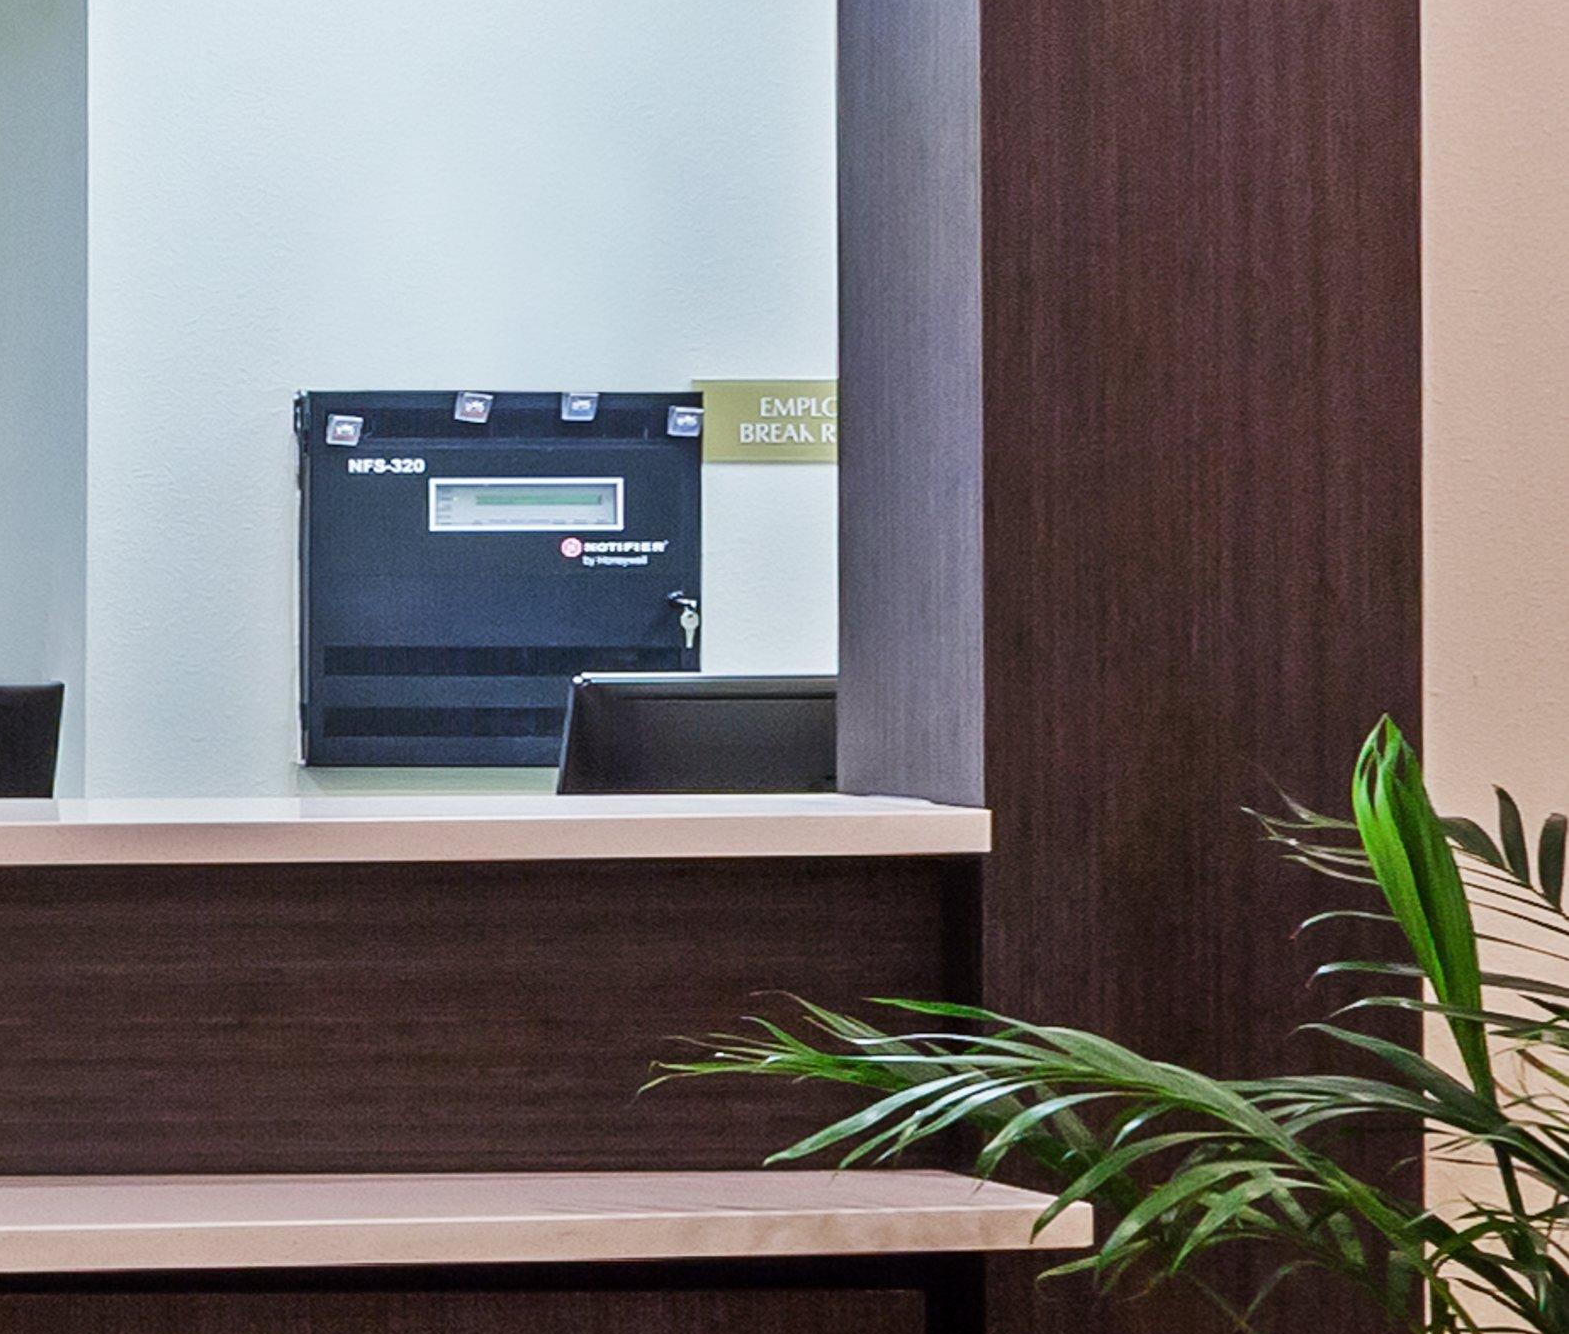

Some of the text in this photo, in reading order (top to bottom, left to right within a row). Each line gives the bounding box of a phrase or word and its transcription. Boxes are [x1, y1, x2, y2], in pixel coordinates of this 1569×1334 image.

[740, 423, 815, 443] BREAK
[348, 459, 426, 473] NFS-320
[583, 542, 665, 553] NOTIFIER
